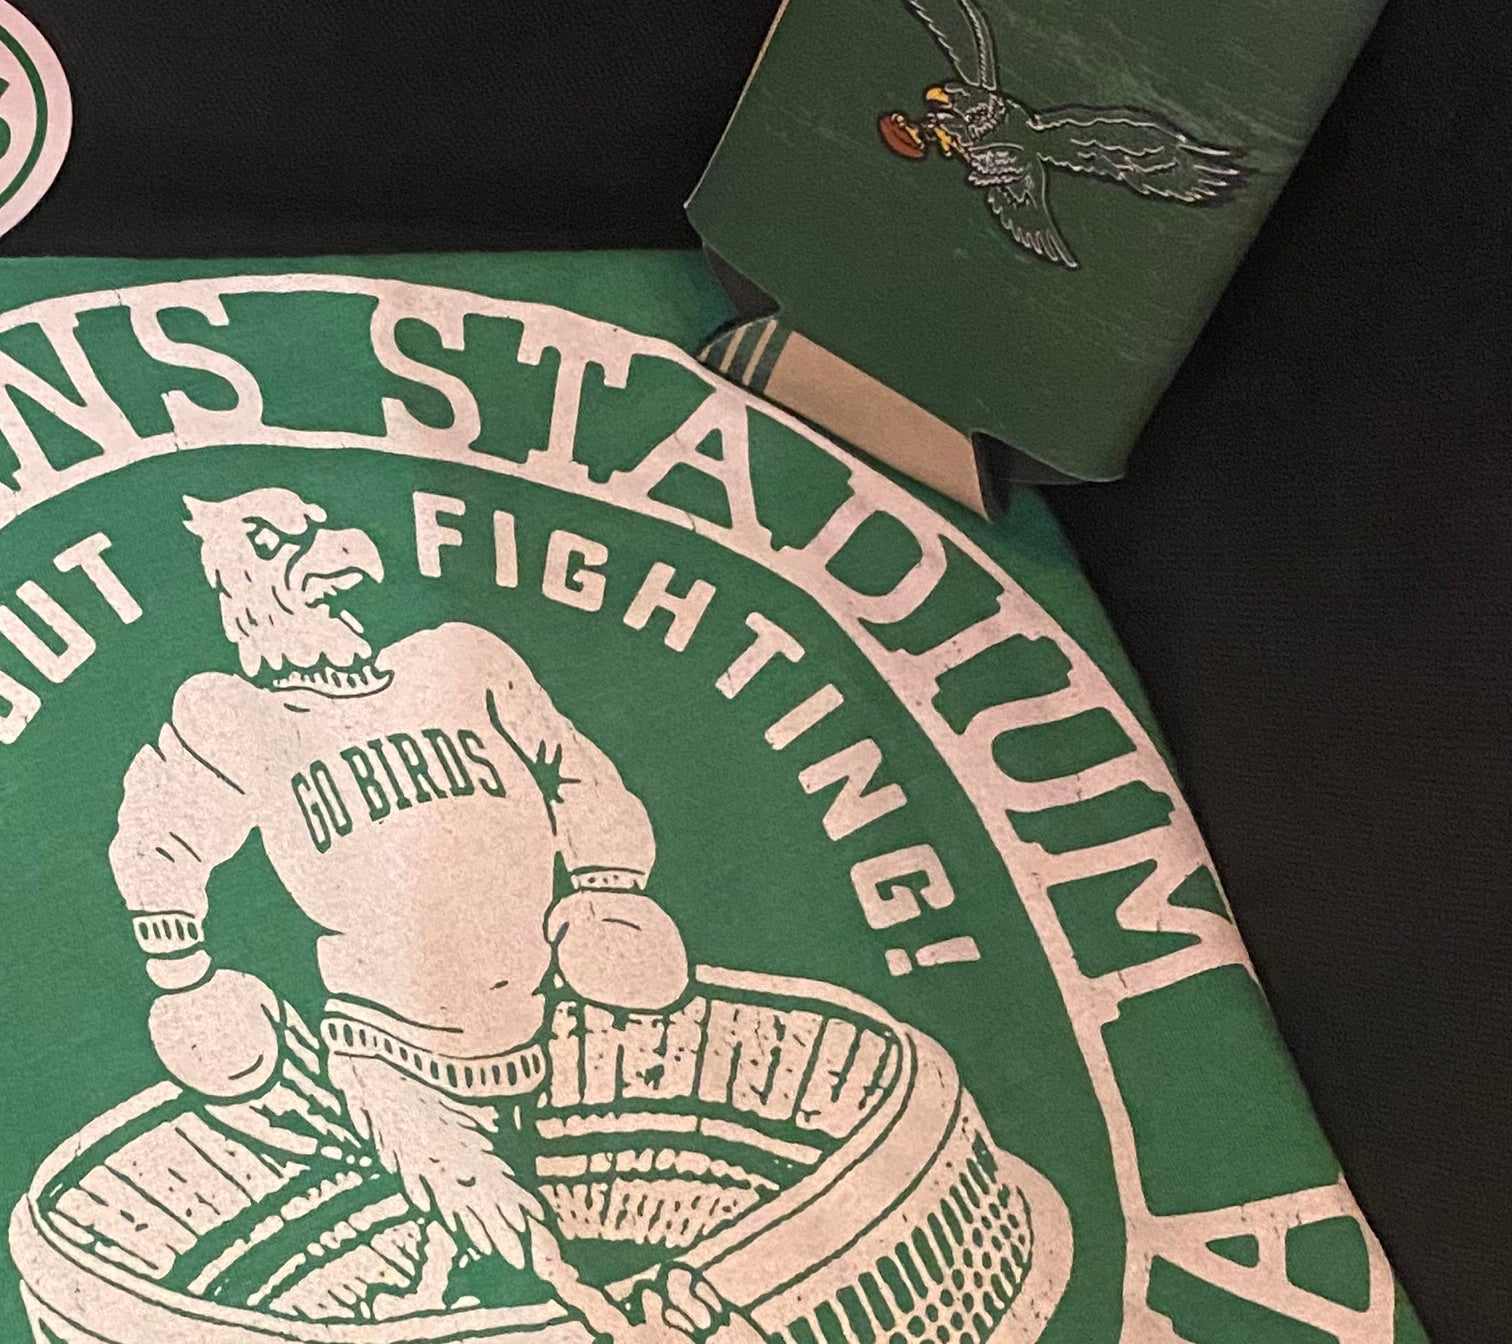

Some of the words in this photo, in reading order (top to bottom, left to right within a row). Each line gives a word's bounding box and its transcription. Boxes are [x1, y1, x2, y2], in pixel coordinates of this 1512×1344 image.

[291, 759, 353, 854] GO
[340, 728, 507, 822] BIRDS
[369, 291, 1264, 1024] STADIUM
[412, 490, 981, 977] FIGHTING!
